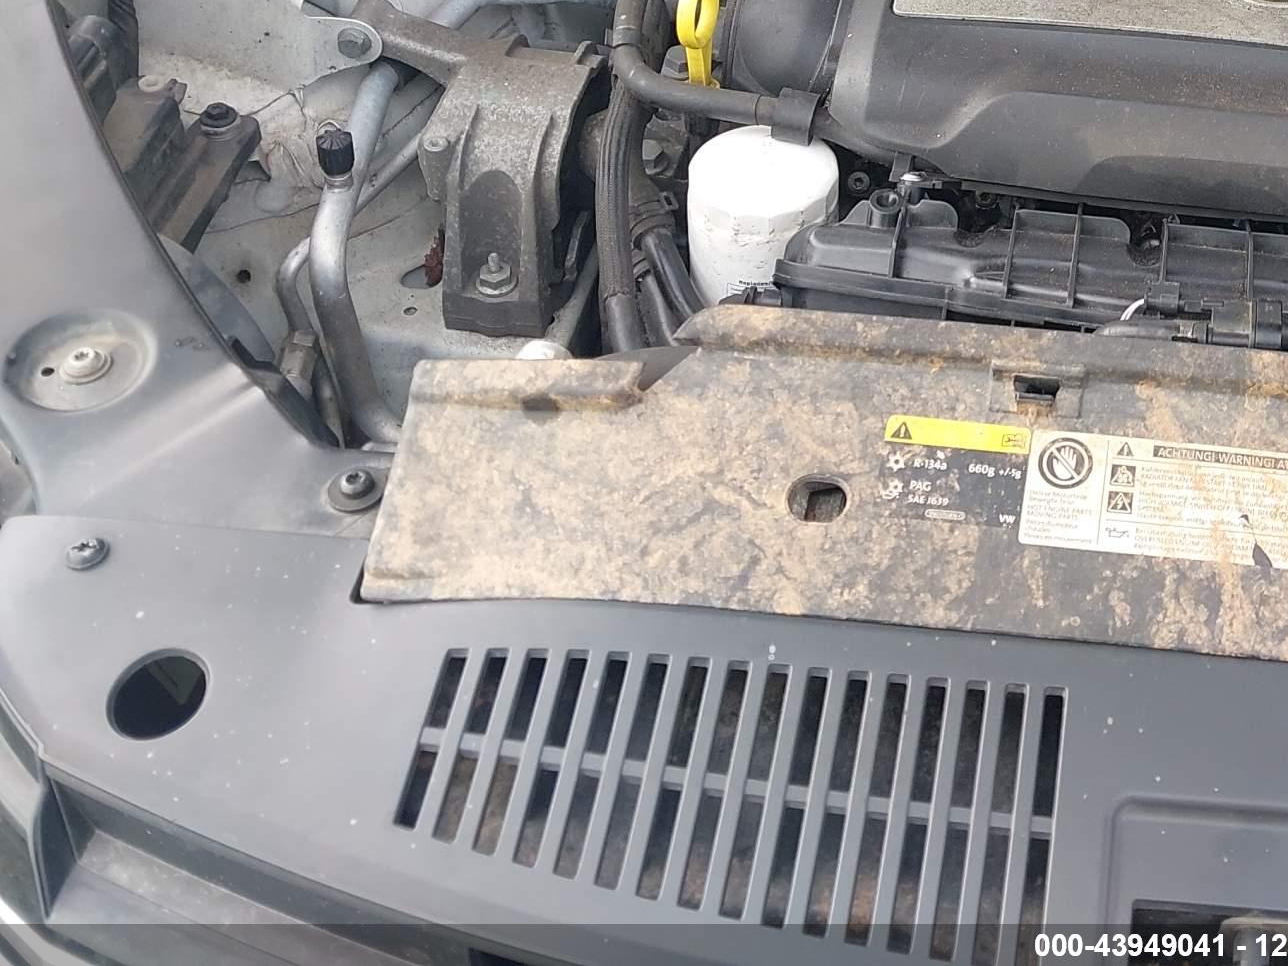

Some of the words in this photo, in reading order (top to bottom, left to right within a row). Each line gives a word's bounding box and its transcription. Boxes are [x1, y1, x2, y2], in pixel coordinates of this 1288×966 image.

[1158, 447, 1214, 462] ACHTUNG!
[1217, 452, 1275, 468] WARNING!
[967, 463, 995, 477] 660g
[997, 466, 1021, 480] +/-5g
[909, 480, 932, 491] PAG
[906, 494, 926, 504] SAE
[998, 513, 1016, 523] VW
